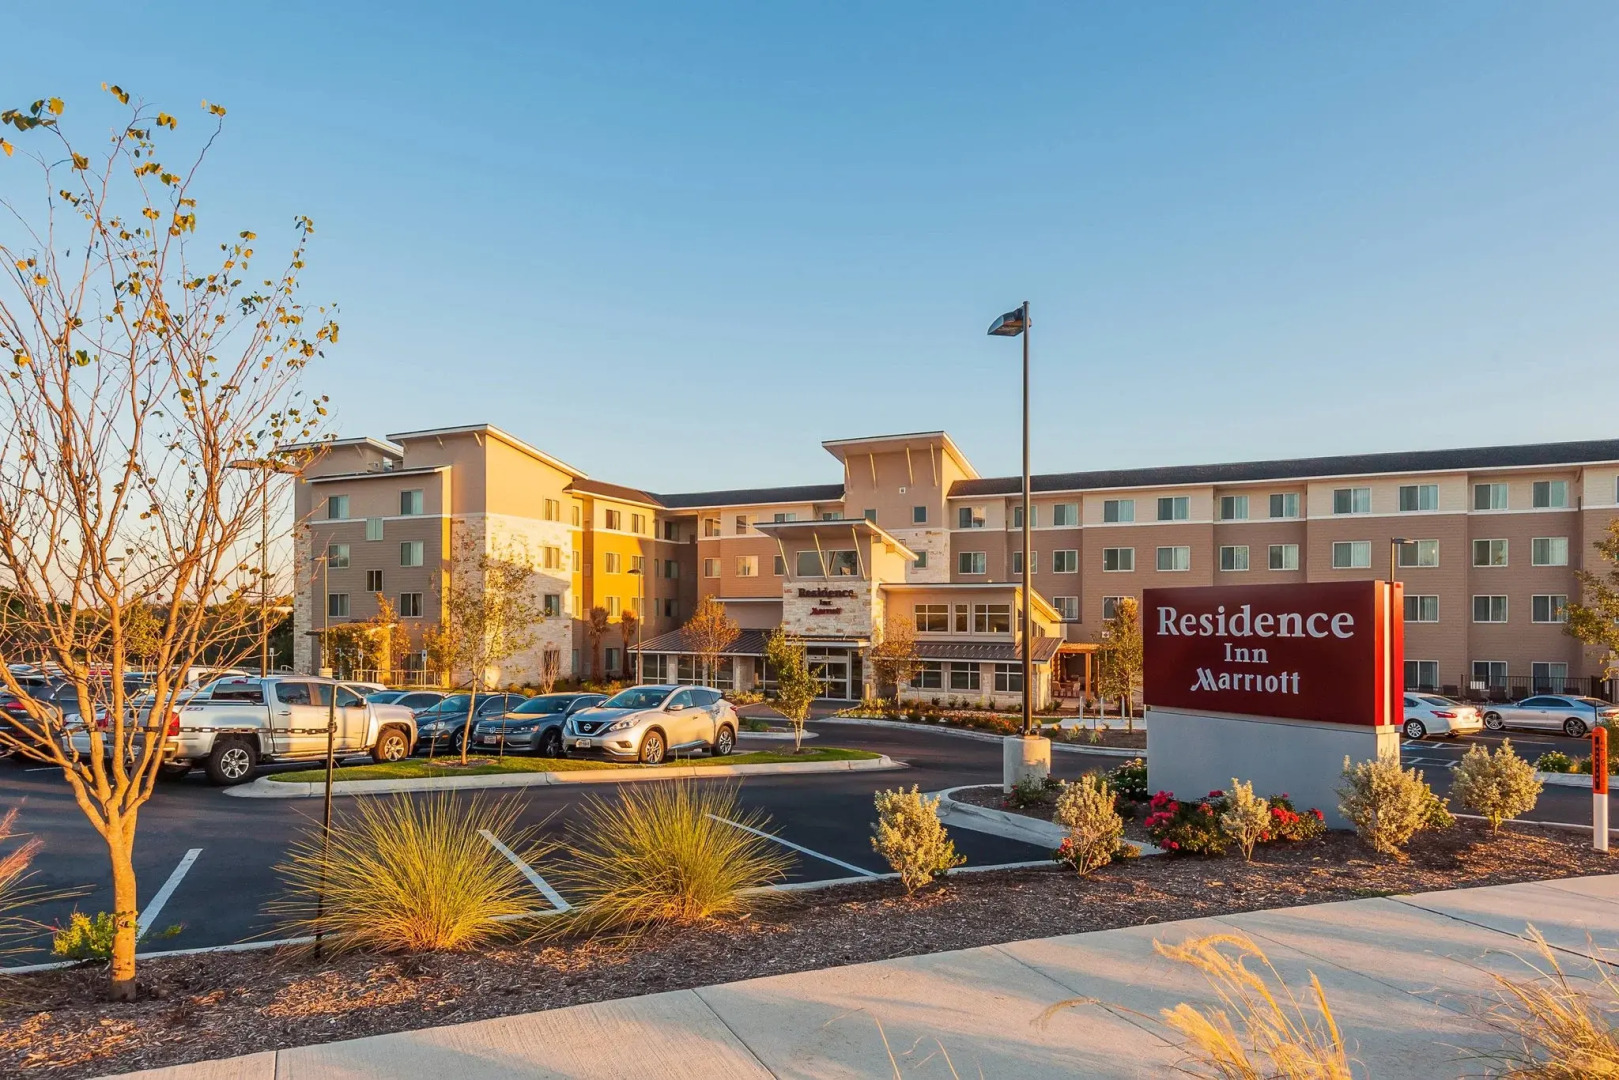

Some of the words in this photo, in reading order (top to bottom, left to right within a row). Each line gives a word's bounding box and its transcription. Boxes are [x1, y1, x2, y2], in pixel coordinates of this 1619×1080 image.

[798, 587, 854, 598] Residence
[1156, 604, 1355, 639] Residence
[1223, 642, 1269, 664] Inn
[1189, 667, 1301, 695] Marriott
